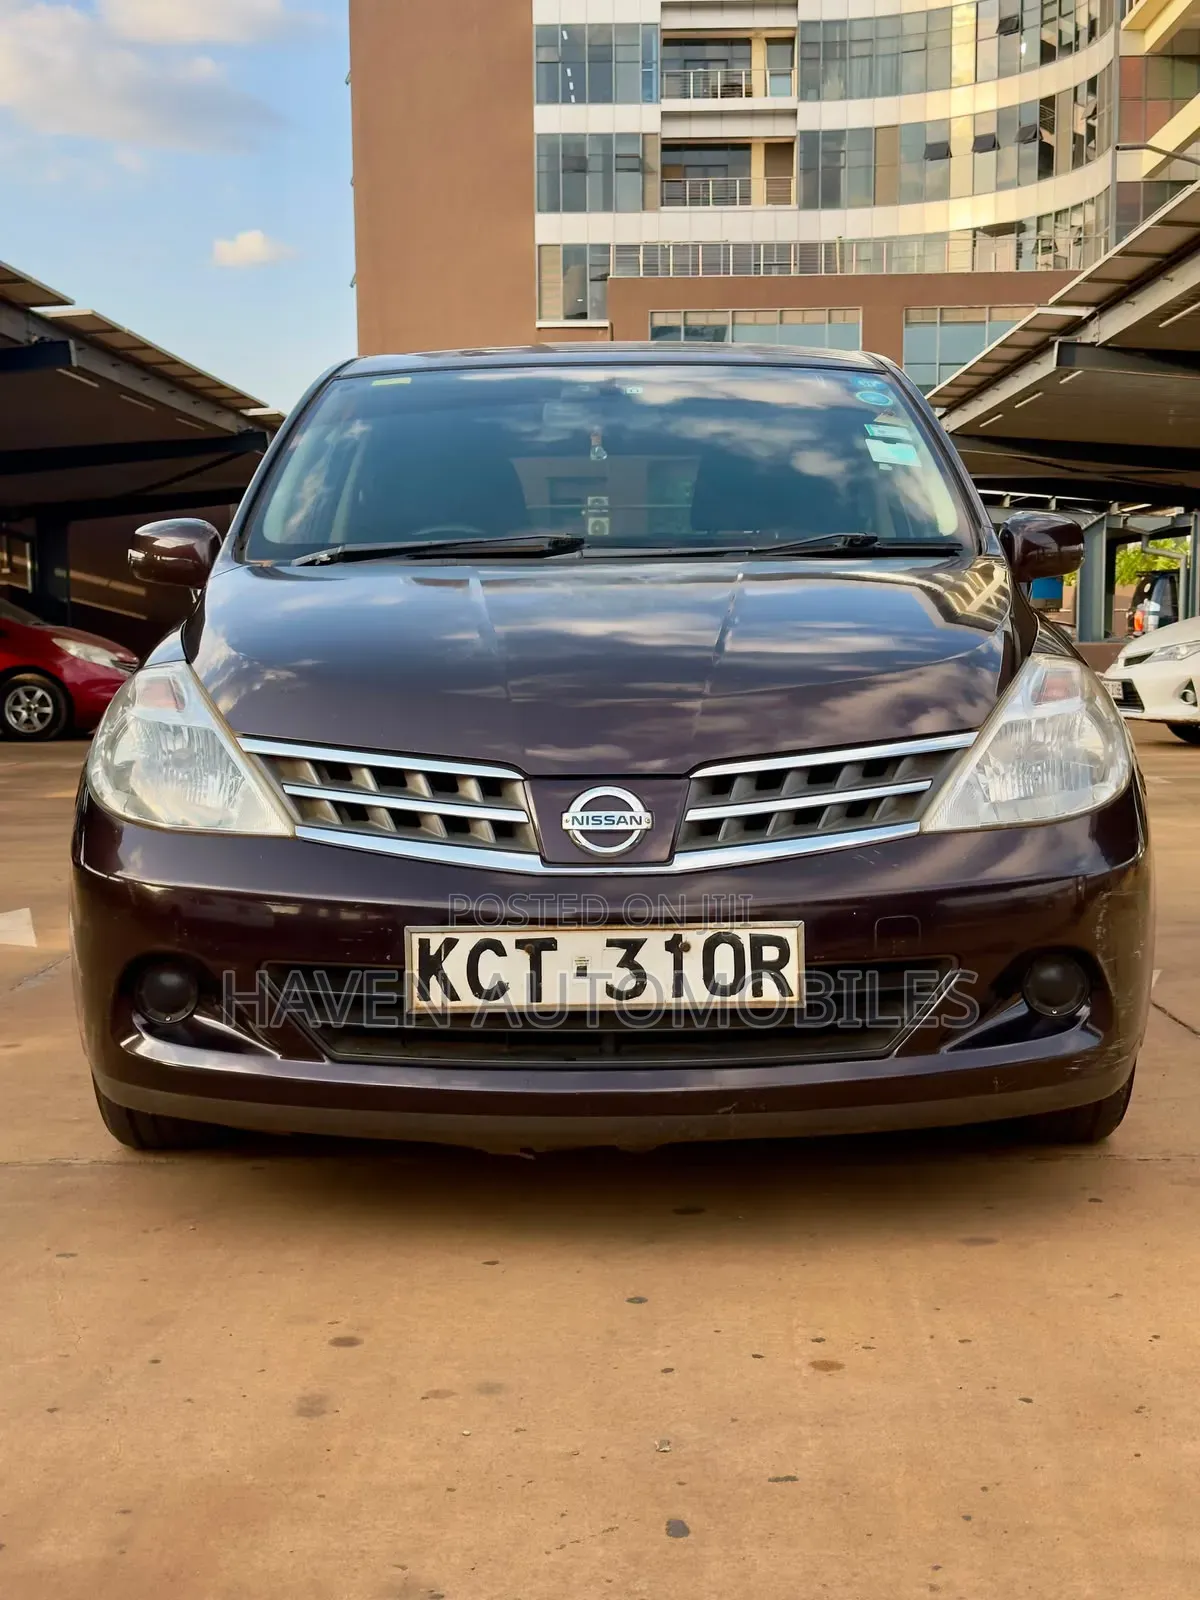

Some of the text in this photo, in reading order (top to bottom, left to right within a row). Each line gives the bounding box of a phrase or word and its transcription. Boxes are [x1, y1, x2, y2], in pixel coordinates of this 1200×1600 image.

[571, 815, 642, 826] NISSAN
[417, 931, 795, 1003] KCT 310R
